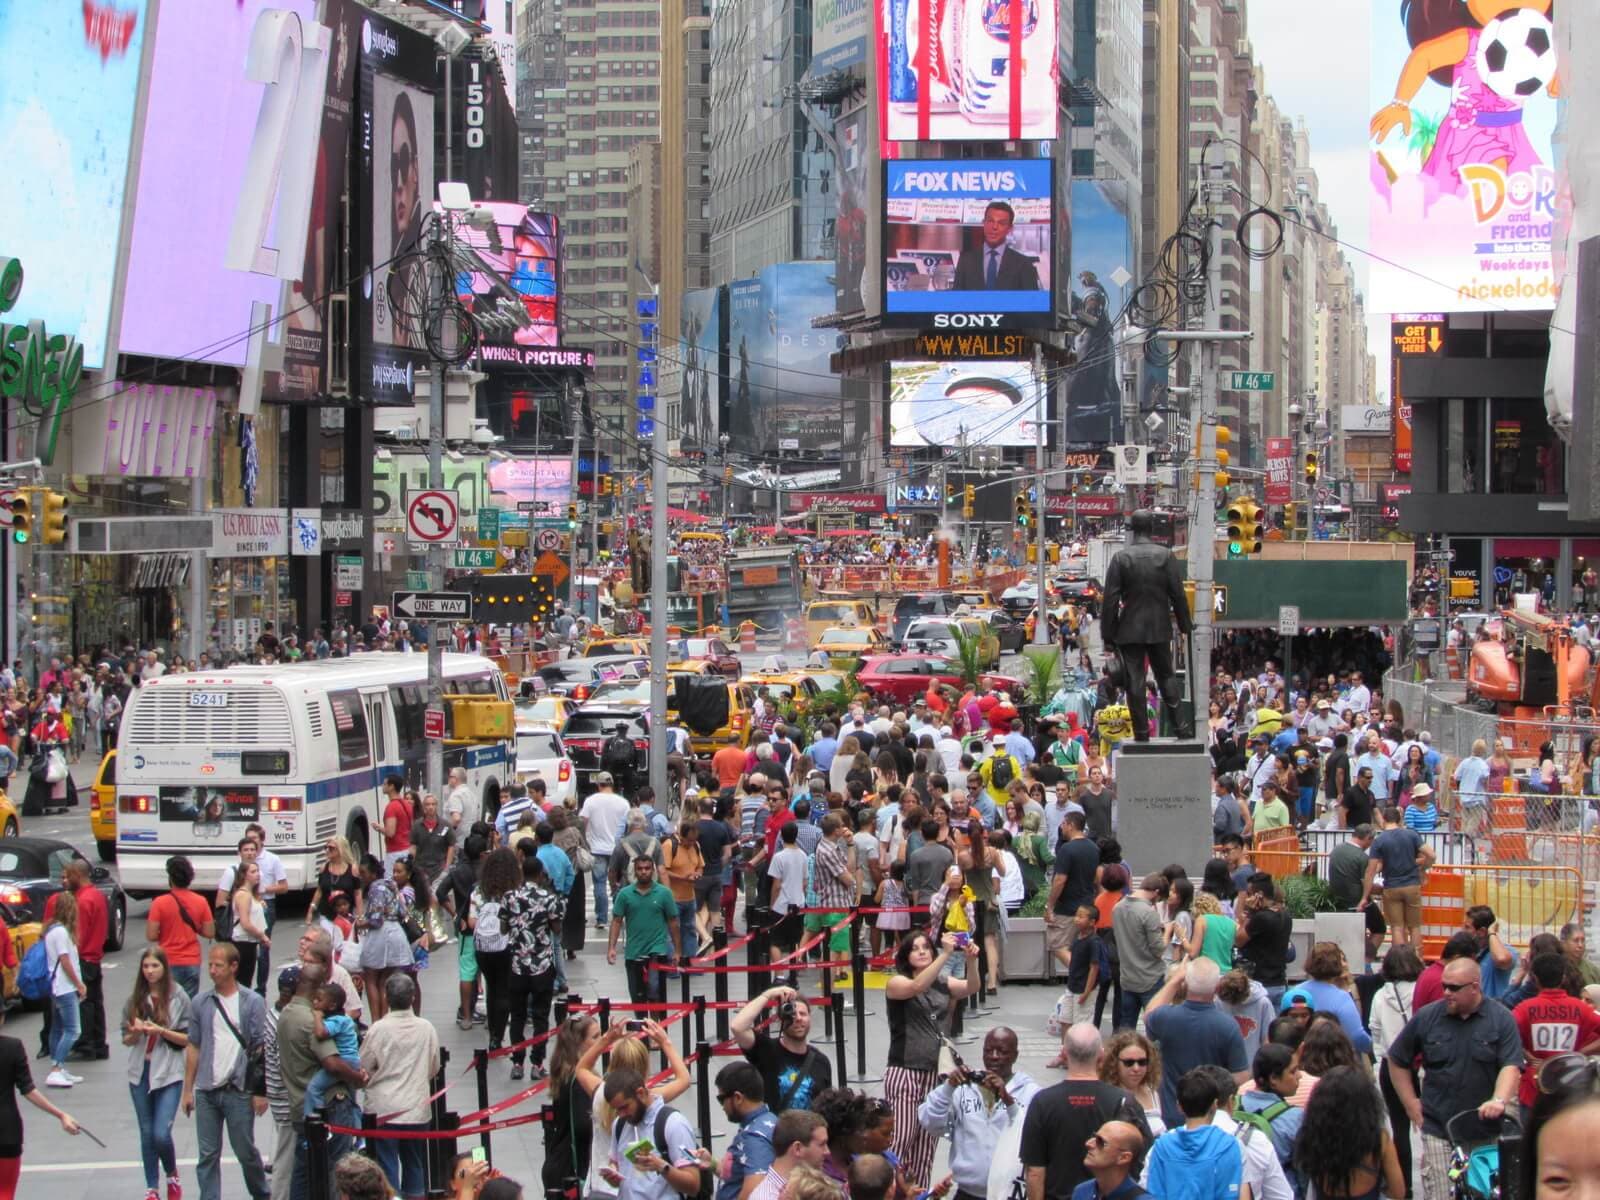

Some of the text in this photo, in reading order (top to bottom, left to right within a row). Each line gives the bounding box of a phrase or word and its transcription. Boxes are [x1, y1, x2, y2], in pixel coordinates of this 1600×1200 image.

[466, 63, 484, 148] 1500
[904, 172, 1016, 191] FOX NEWS
[1507, 212, 1530, 222] and
[1480, 259, 1549, 271] Weekdays
[934, 314, 1003, 328] SONY
[1404, 326, 1426, 336] GET
[1394, 336, 1426, 344] TICKETS
[1402, 344, 1426, 353] HERE
[525, 351, 582, 365] PICTURE
[1234, 374, 1271, 389] W 46 ST
[1267, 457, 1291, 470] JERSEY
[238, 514, 258, 536] POLO
[237, 542, 255, 552] SINCE
[458, 552, 493, 565] W 46 ST
[414, 601, 463, 611] ONE WAY
[643, 598, 694, 610] TLLY
[192, 694, 224, 706] 5241
[1529, 1005, 1580, 1019] RUSSIA
[1537, 1026, 1573, 1050] 012
